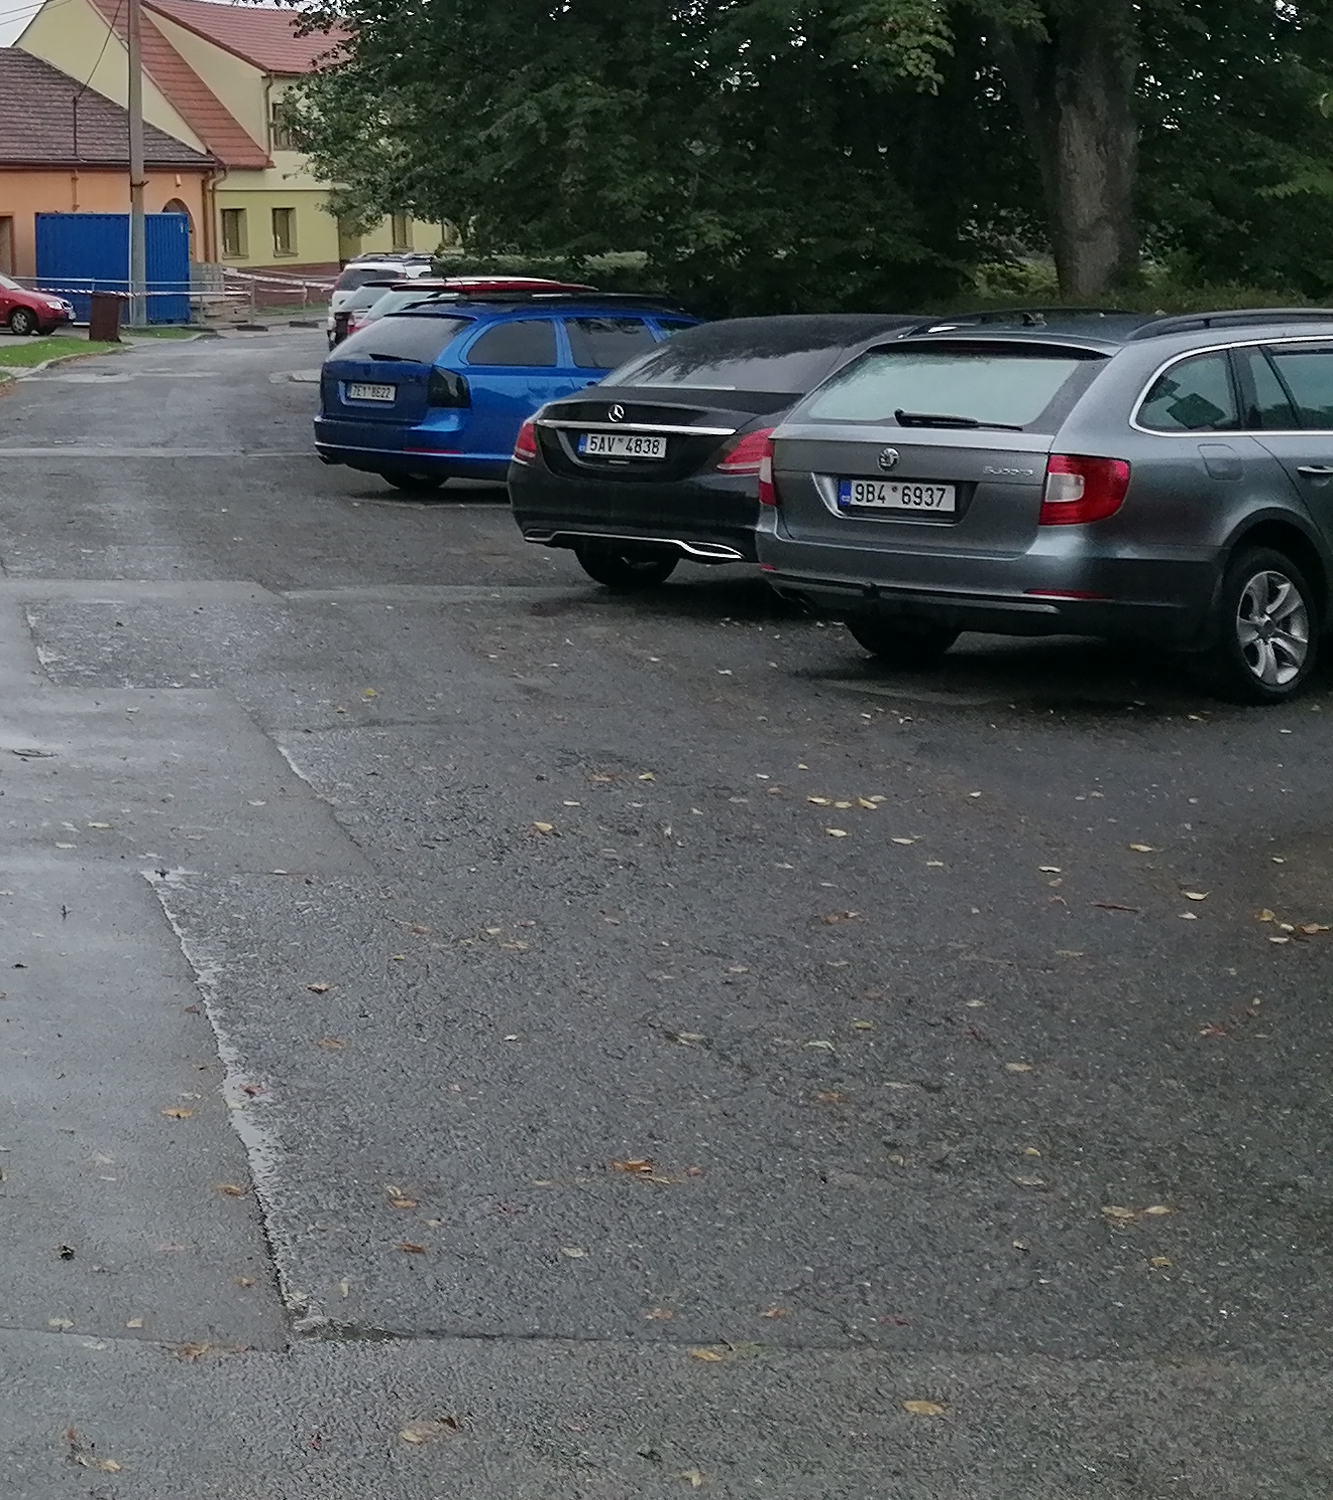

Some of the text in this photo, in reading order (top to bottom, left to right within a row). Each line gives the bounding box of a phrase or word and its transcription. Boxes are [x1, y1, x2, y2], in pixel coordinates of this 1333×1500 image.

[589, 436, 616, 452] 5AV
[625, 438, 660, 455] 4838
[855, 483, 946, 508] 9B4 6937
